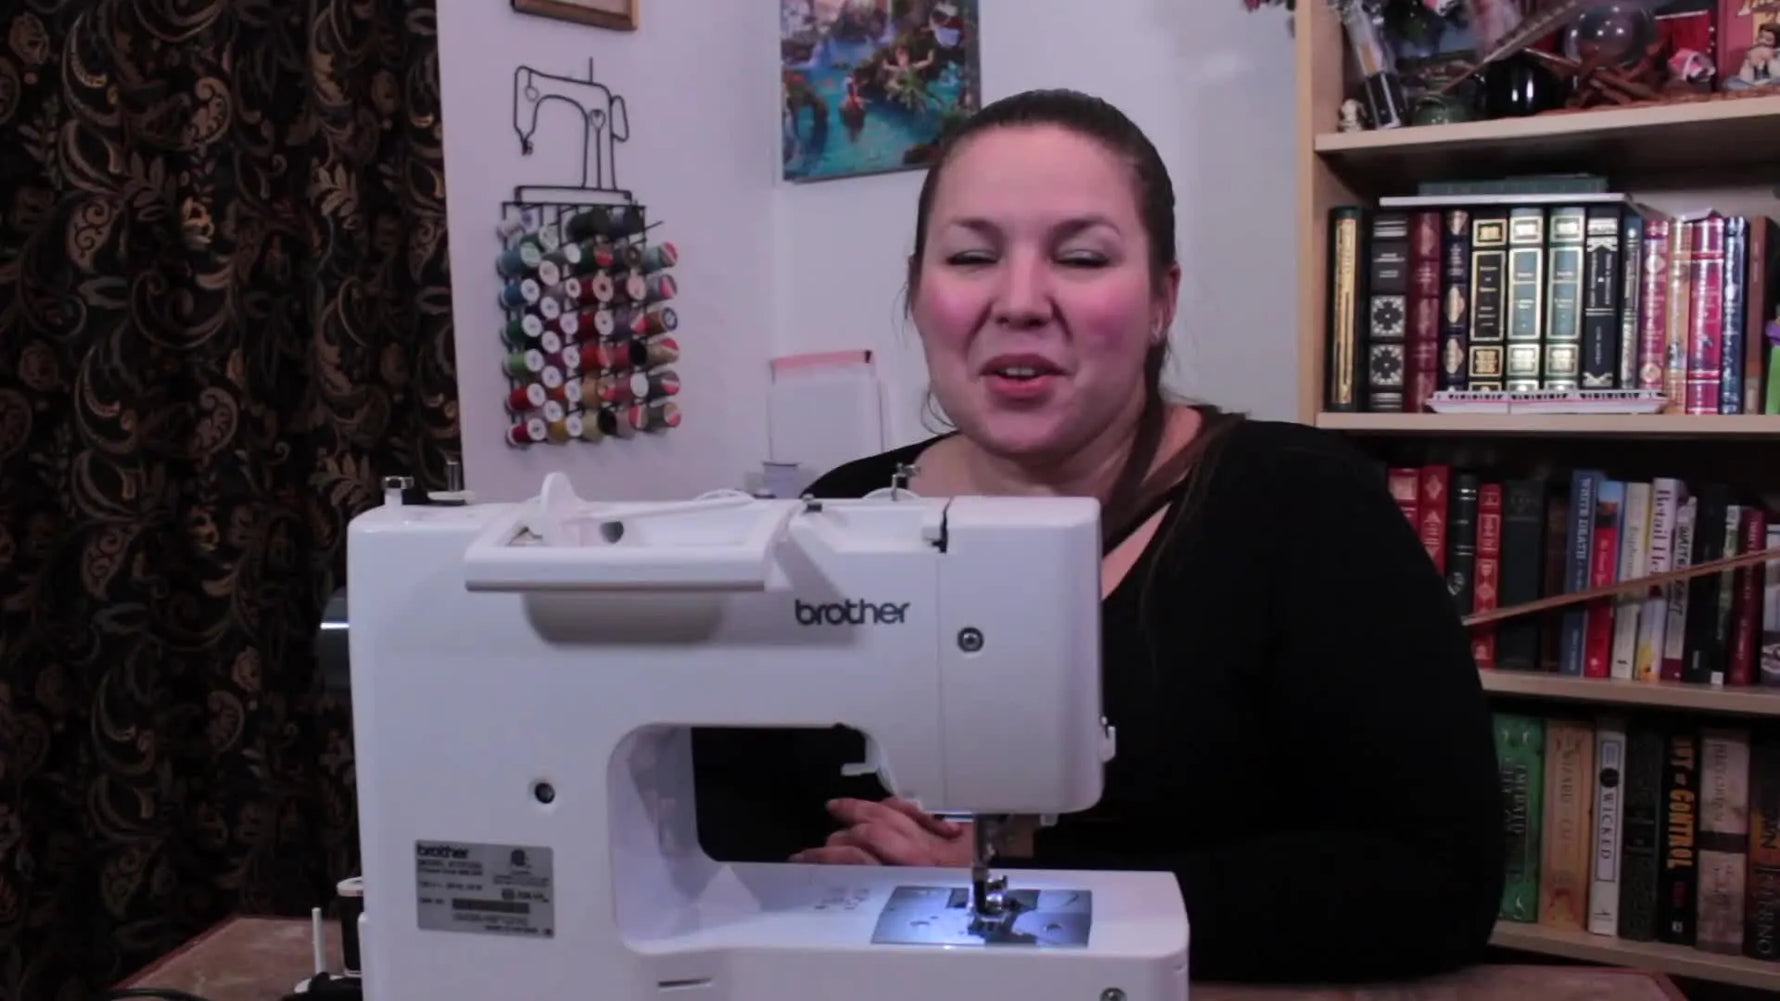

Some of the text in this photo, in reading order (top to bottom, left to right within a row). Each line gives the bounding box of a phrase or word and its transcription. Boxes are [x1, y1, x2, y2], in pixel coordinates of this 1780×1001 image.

[795, 598, 910, 626] brother
[1599, 791, 1616, 860] WICKED
[1666, 789, 1696, 868] CONTROL
[417, 846, 468, 859] brother
